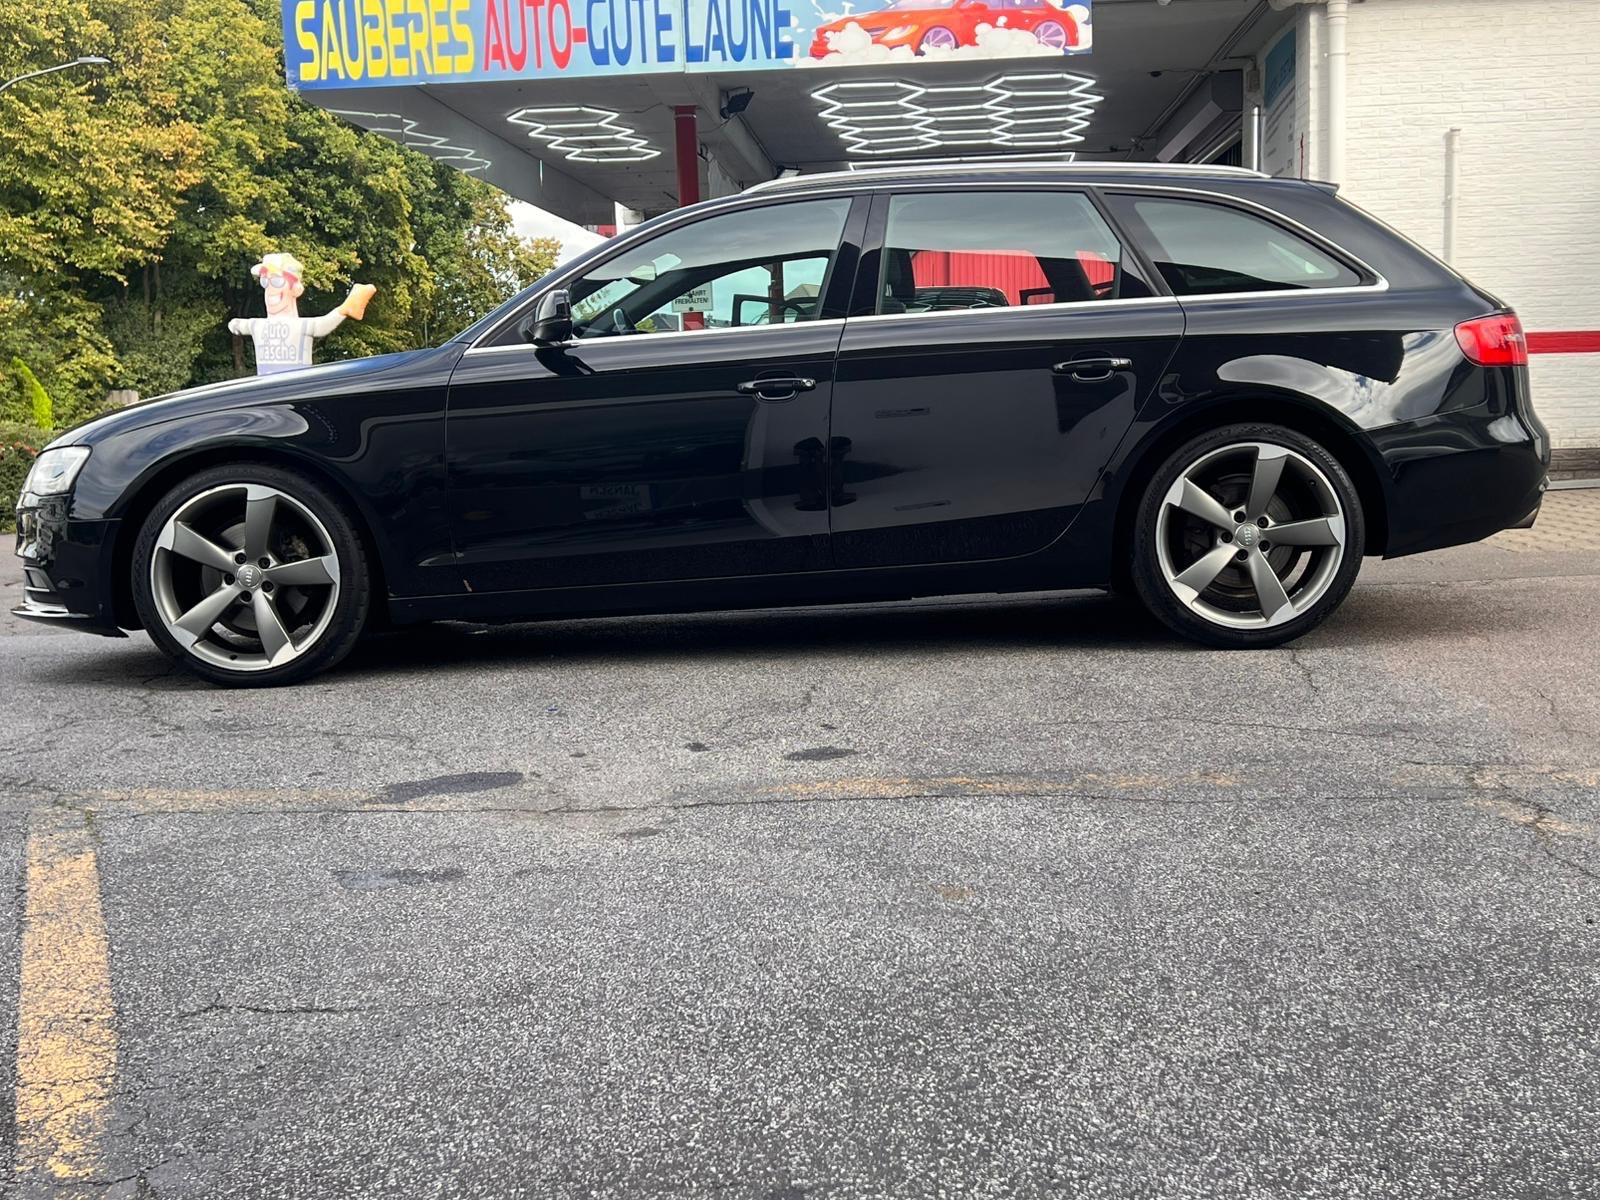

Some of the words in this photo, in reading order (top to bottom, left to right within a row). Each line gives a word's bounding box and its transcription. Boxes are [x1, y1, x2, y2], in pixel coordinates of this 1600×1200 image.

[295, 0, 474, 81] SAUBERES
[684, 0, 793, 62] LAUNE
[262, 322, 289, 339] Auto
